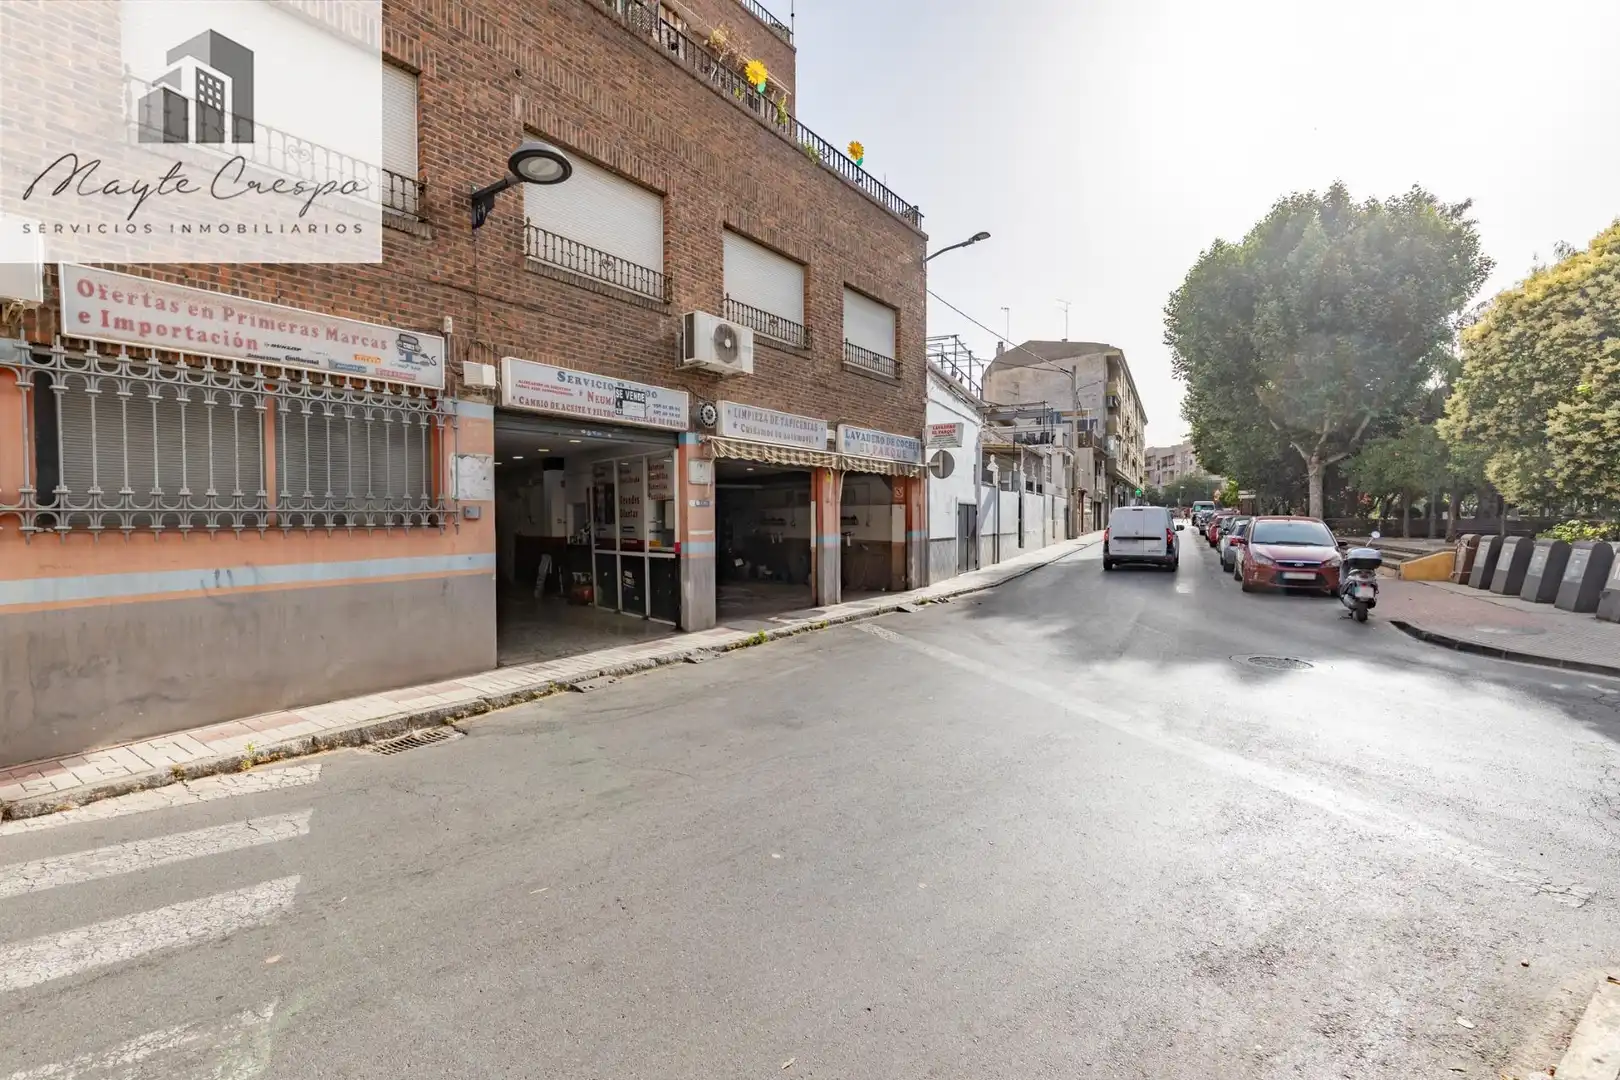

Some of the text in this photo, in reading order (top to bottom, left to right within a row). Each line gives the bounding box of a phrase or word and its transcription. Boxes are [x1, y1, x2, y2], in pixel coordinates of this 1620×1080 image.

[77, 278, 388, 351] Ofertas en Primeras Marcas
[78, 309, 259, 351] e Importación
[557, 371, 614, 390] SERVICIO
[616, 388, 645, 402] SE VENDE
[519, 396, 549, 408] CAMBIO
[550, 402, 561, 410] DE
[561, 404, 586, 414] ACEITE
[733, 408, 768, 424] LIMPIEZA
[770, 415, 780, 425] DE
[845, 429, 885, 444] LAVADERO
[886, 437, 895, 446] DE
[895, 439, 919, 452] COCHES
[860, 442, 908, 459] EL PARQUE
